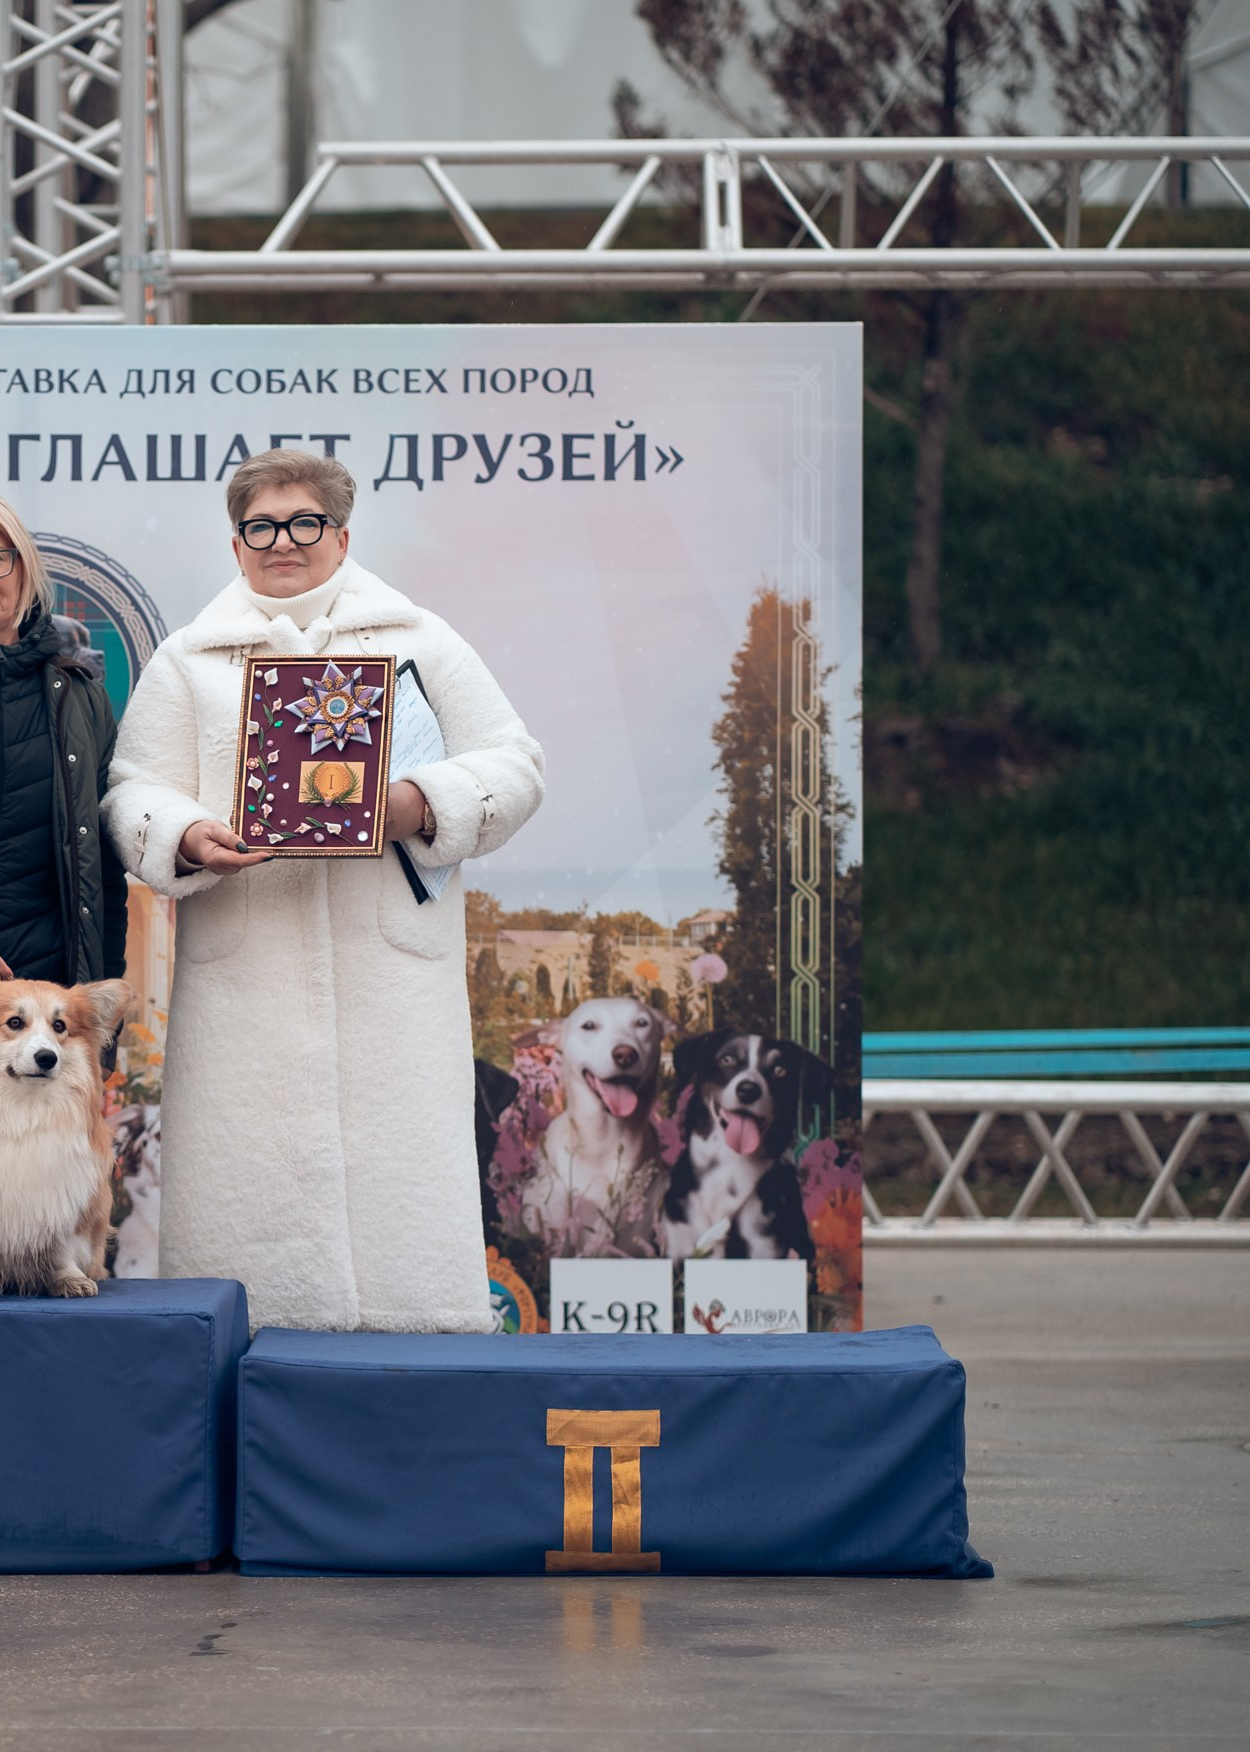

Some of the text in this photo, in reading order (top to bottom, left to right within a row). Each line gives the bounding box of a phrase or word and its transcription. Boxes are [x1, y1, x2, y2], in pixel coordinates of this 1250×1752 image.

[120, 369, 194, 398] ДЛЯ
[210, 368, 338, 395] СОБАК
[353, 368, 448, 395] ВСЕХ
[463, 368, 594, 398] ПОРОД
[373, 420, 684, 491] ДРУЗЕЙ»
[561, 1300, 660, 1333] K-9R
